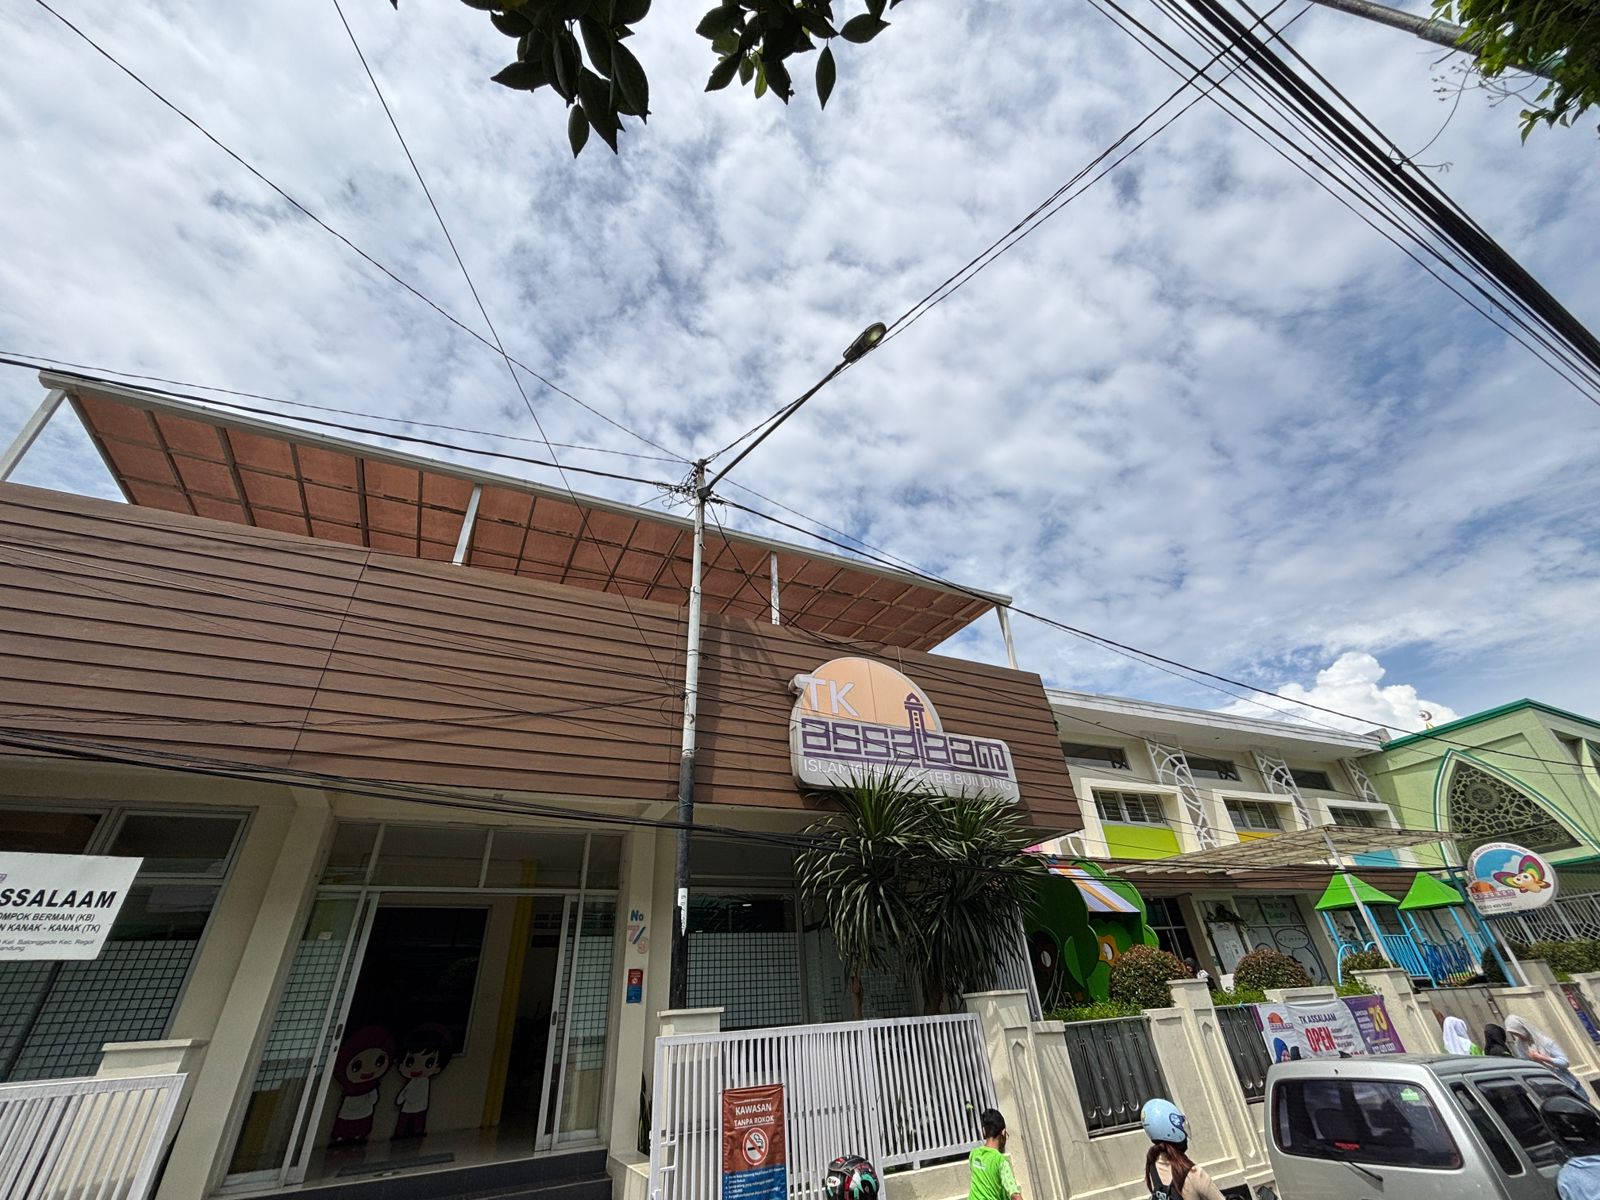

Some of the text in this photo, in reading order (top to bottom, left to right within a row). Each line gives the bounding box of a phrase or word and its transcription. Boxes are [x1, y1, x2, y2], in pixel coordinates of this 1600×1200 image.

[800, 676, 859, 717] TK
[954, 773, 1012, 791] BUILDING
[32, 913, 75, 921] BERMAIN
[75, 913, 96, 923] (KB)
[630, 910, 644, 922] No
[48, 924, 82, 932] KANAK
[82, 924, 101, 933] (TK)
[1299, 1013, 1337, 1025] TK ASSALAAM
[1305, 1026, 1337, 1053] OPEN
[735, 1103, 773, 1116] KAWASAN
[734, 1115, 775, 1127] TANPA ROKOK
